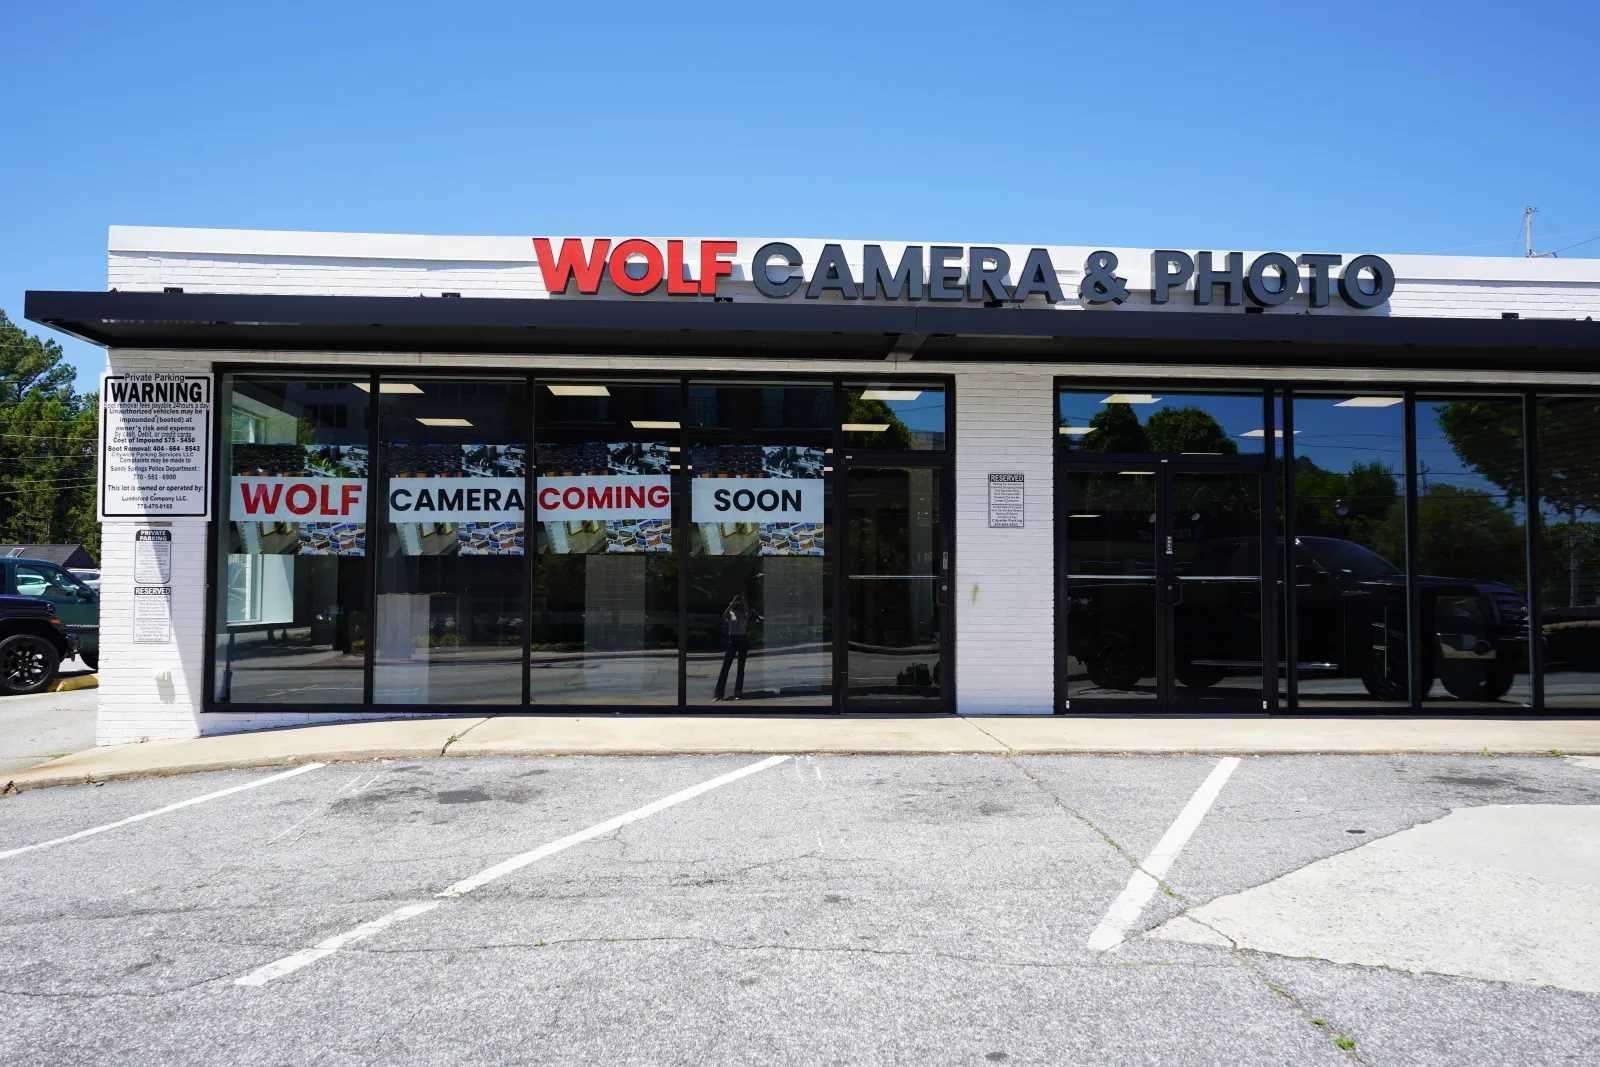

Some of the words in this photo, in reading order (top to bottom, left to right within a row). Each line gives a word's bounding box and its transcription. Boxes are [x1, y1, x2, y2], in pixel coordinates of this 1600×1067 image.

[532, 237, 738, 295] WOLF
[751, 241, 1065, 301] CAMERA
[1078, 249, 1131, 306] &
[1150, 249, 1396, 309] PHOTO
[124, 373, 152, 381] Private
[154, 373, 184, 383] Parking
[110, 382, 202, 402] WARNING
[240, 483, 362, 516] WOLF
[390, 488, 525, 512] CAMERA
[538, 486, 670, 510] COMING
[714, 488, 802, 512] SOON
